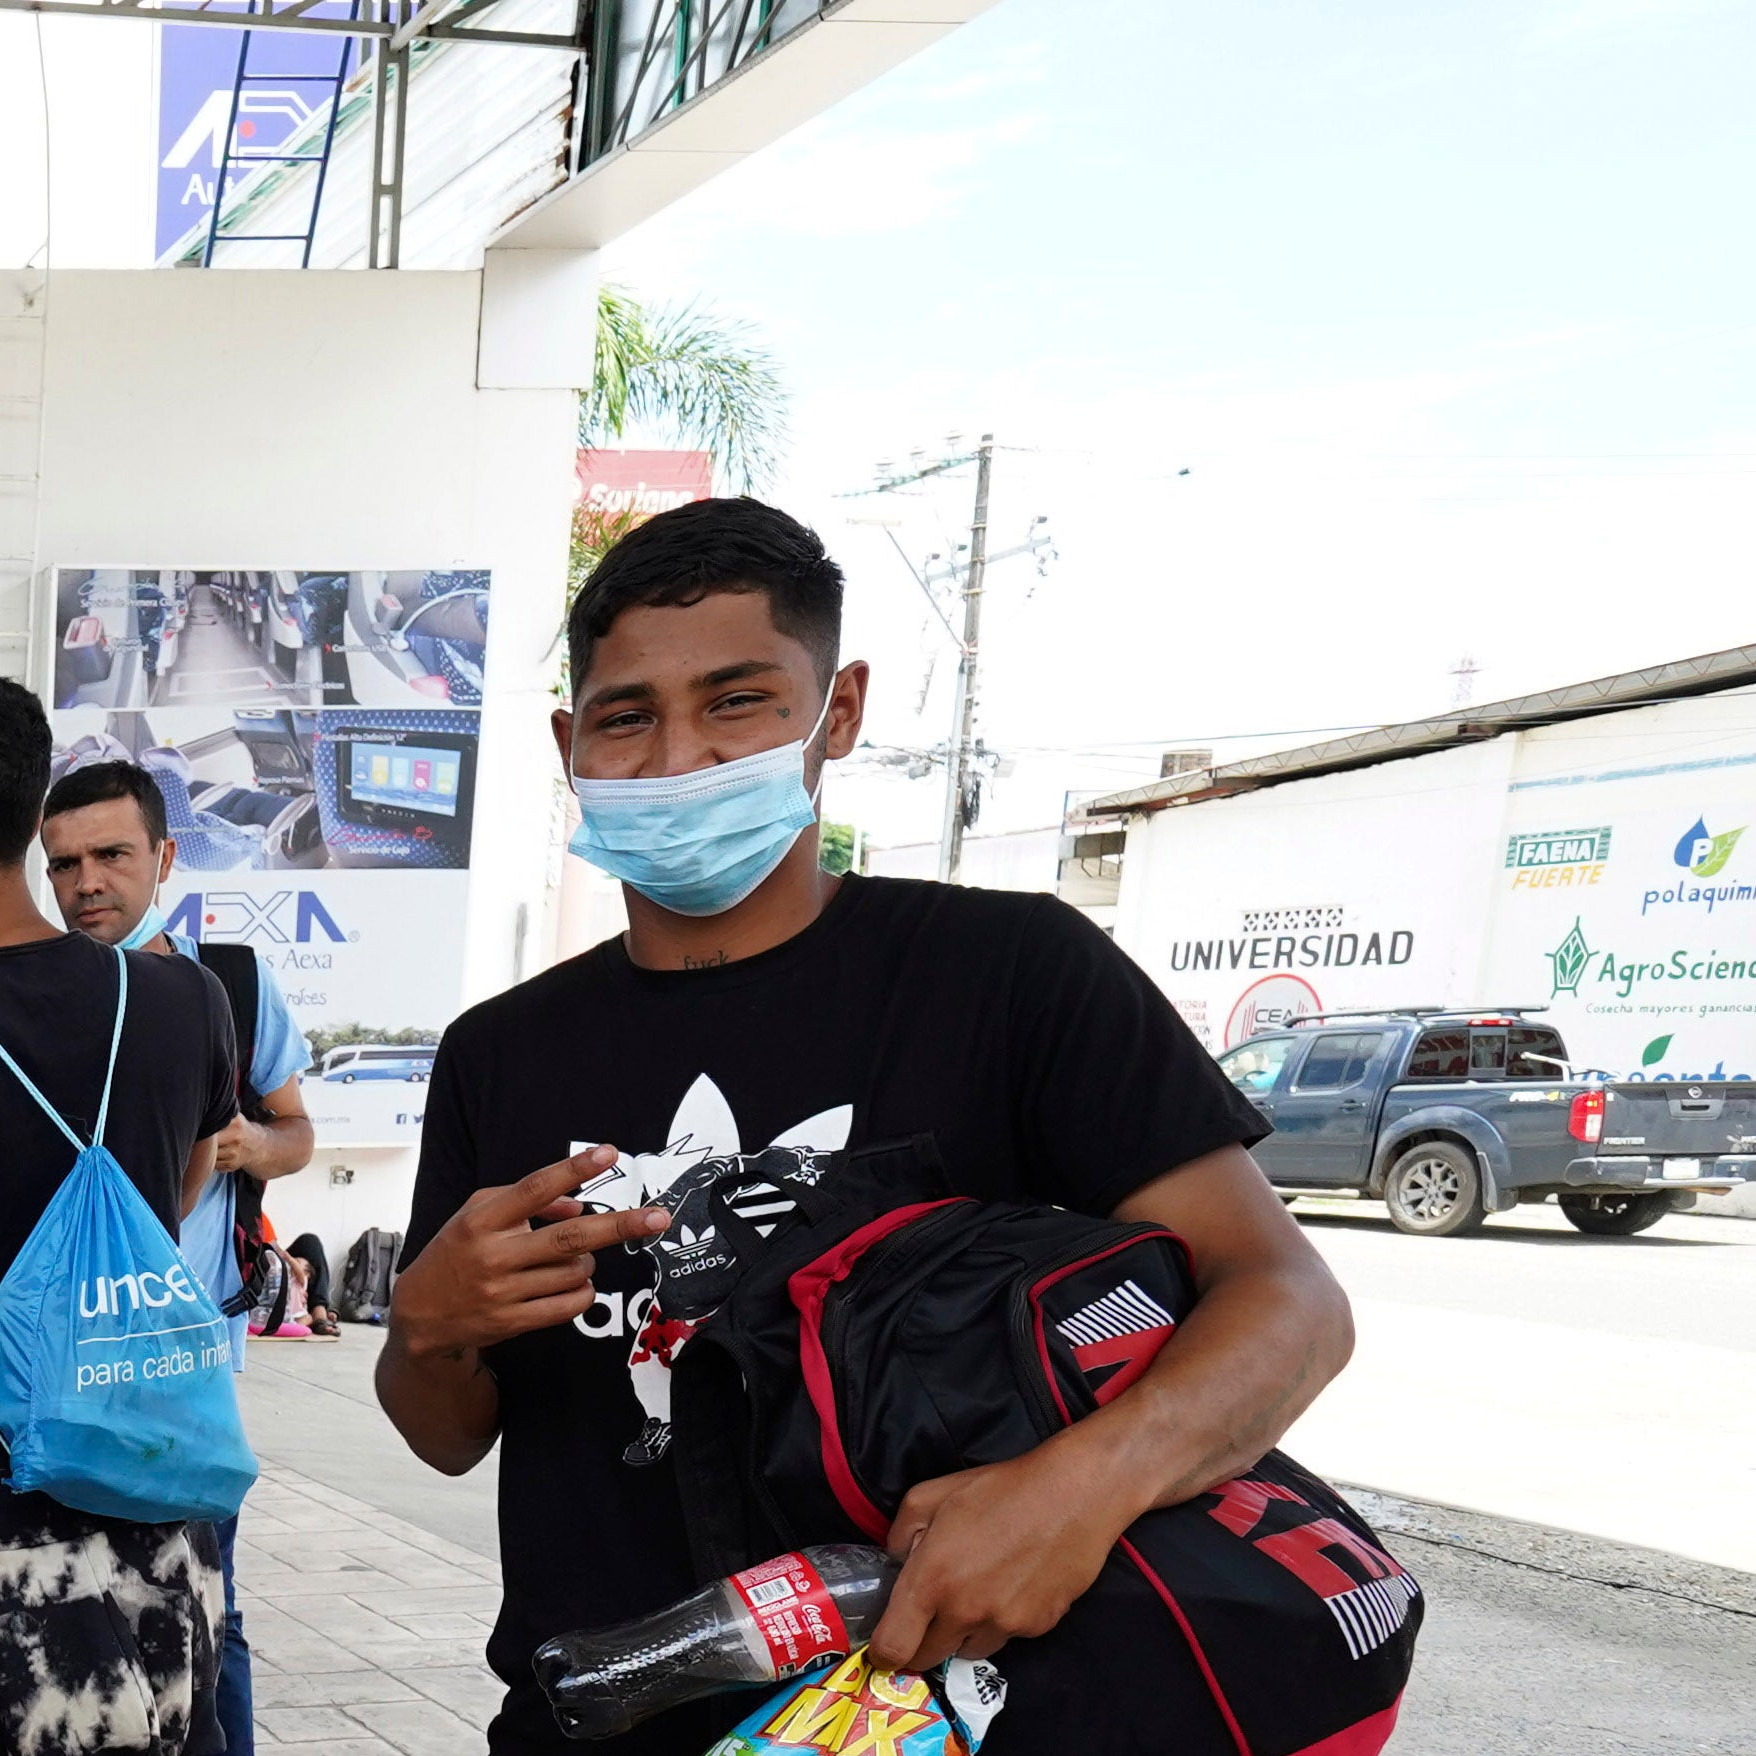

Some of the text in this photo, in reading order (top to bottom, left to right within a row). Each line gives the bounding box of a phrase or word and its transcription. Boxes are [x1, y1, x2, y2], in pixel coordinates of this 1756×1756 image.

[1521, 838, 1592, 865] FAENA
[1512, 864, 1605, 890] FUERTE
[281, 948, 332, 970] Aexa
[1171, 930, 1414, 971] UNIVERSIDAD
[1586, 1002, 1633, 1014] Cosecha
[1639, 1003, 1694, 1018] mayores
[669, 1252, 727, 1279] adidas
[77, 1359, 134, 1393] para
[143, 1346, 195, 1379] cada
